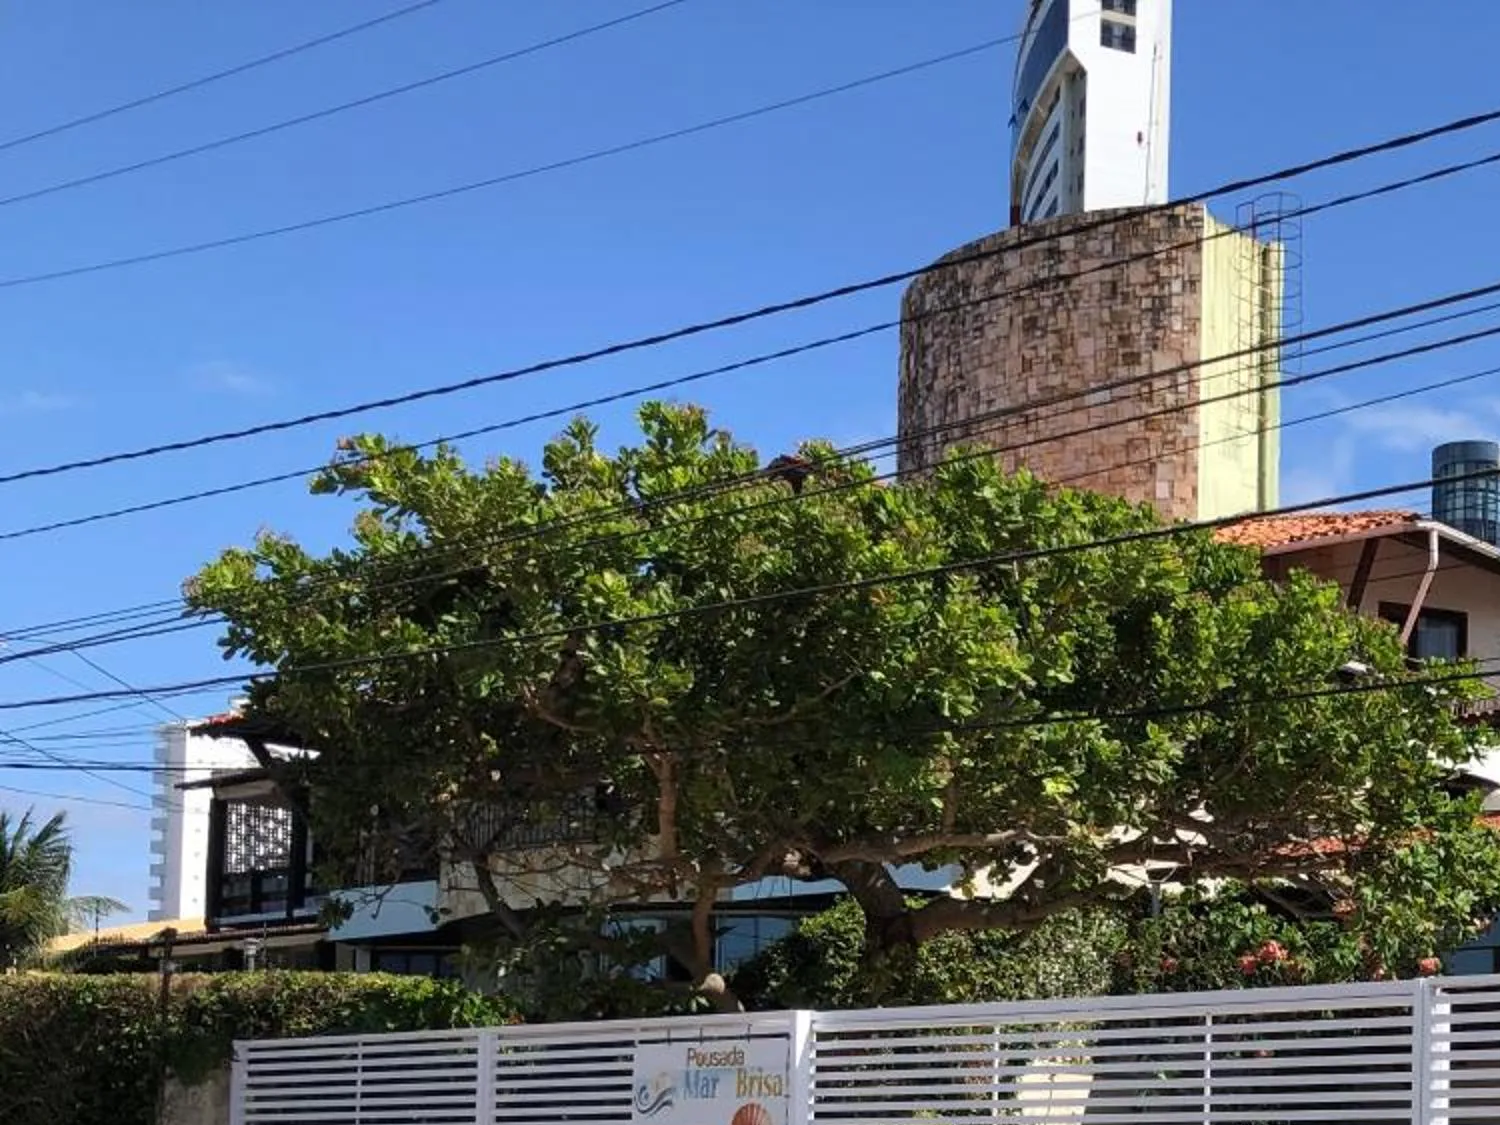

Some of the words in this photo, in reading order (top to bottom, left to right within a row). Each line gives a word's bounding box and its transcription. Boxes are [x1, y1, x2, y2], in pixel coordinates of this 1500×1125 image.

[687, 1047, 745, 1067] Pousada
[684, 1069, 719, 1098] Mar
[736, 1066, 783, 1097] Brisa
